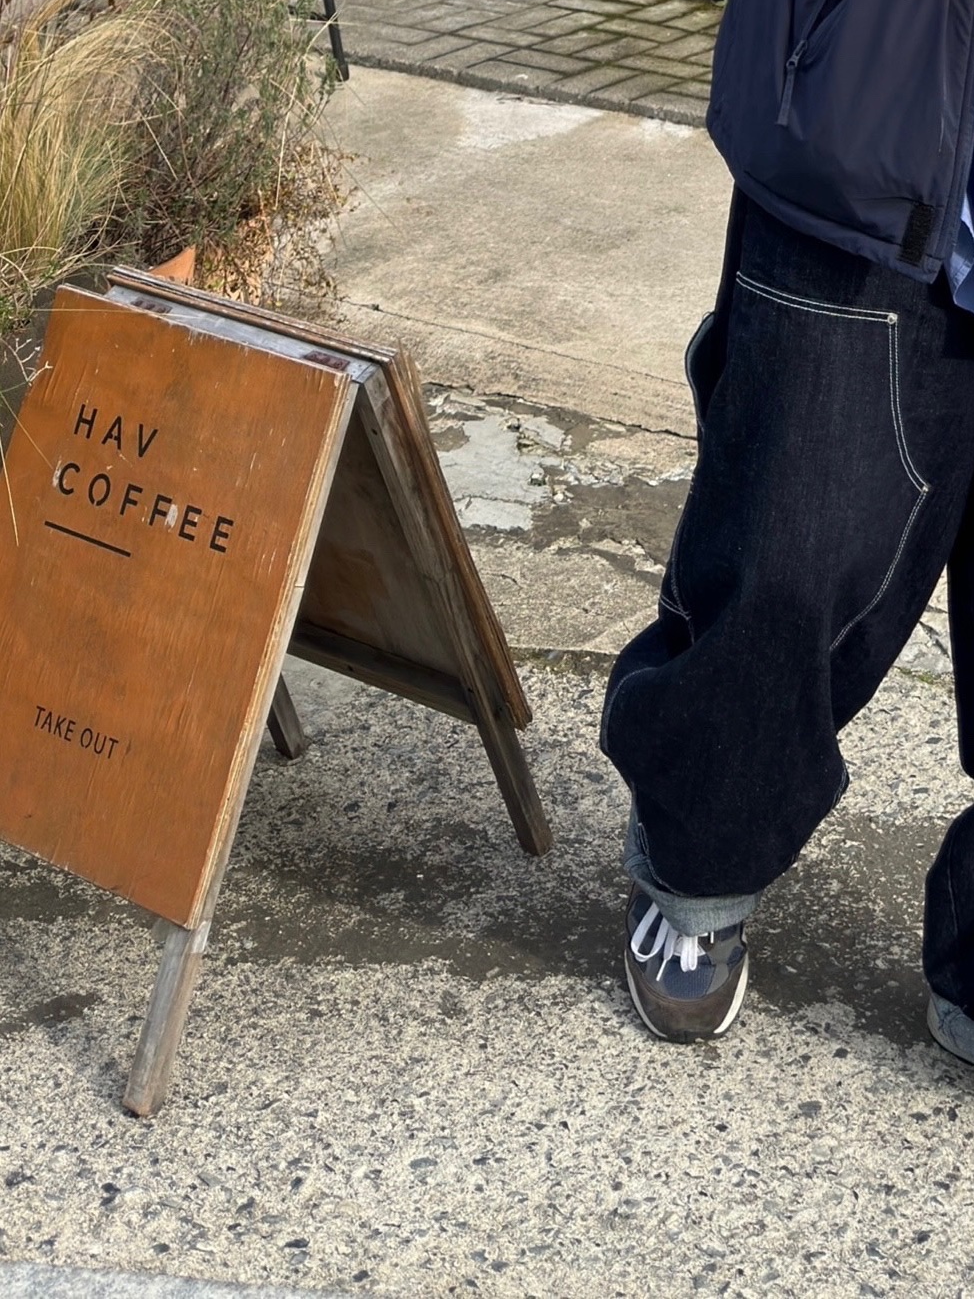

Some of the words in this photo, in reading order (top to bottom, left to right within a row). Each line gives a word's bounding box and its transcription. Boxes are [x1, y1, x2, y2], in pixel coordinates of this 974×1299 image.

[74, 404, 158, 458] HAV
[58, 462, 234, 553] COFFEE
[34, 705, 76, 742] TAKE
[80, 728, 119, 759] OUT
